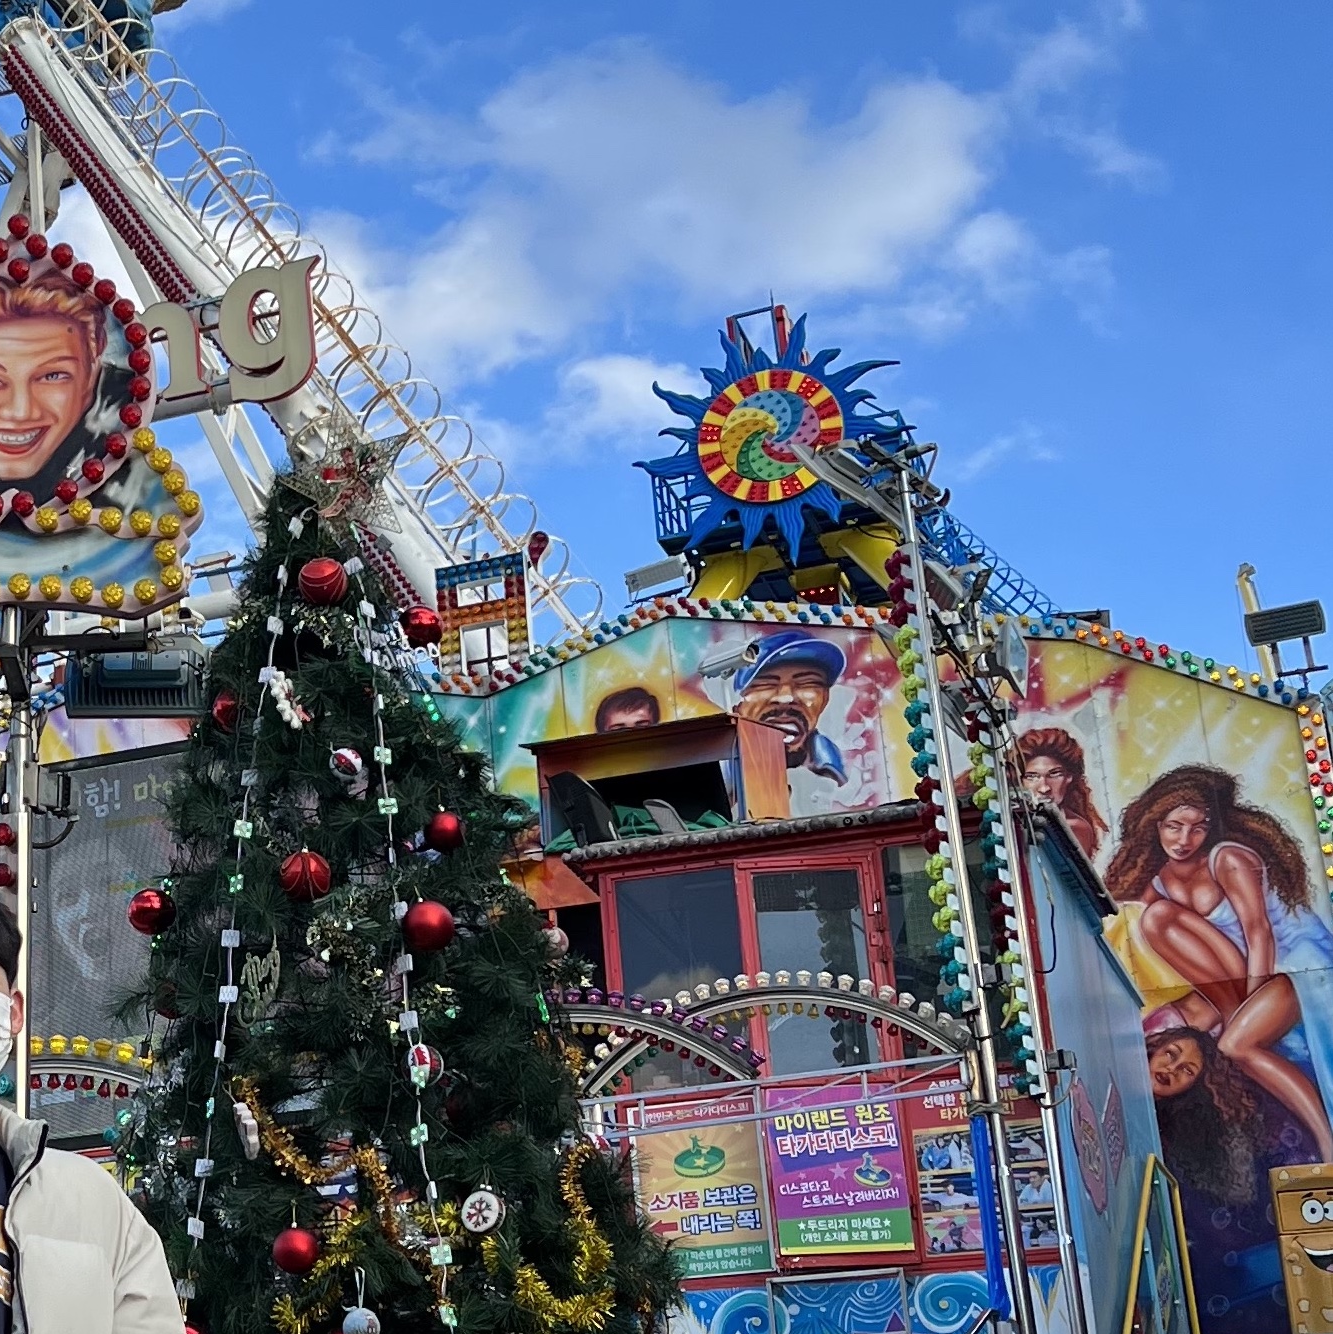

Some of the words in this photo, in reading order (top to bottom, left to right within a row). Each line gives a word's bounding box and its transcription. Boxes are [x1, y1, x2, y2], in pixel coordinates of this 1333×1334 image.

[774, 1107, 849, 1132] 마이랜드
[854, 1103, 894, 1126] 원조
[776, 1123, 899, 1158] 타가다디스코!
[648, 1189, 701, 1213] 소지품
[704, 1183, 758, 1208] 보관은
[779, 1180, 831, 1196] 디스코타고
[681, 1212, 734, 1236] 내리는
[736, 1209, 763, 1231] 쪽!
